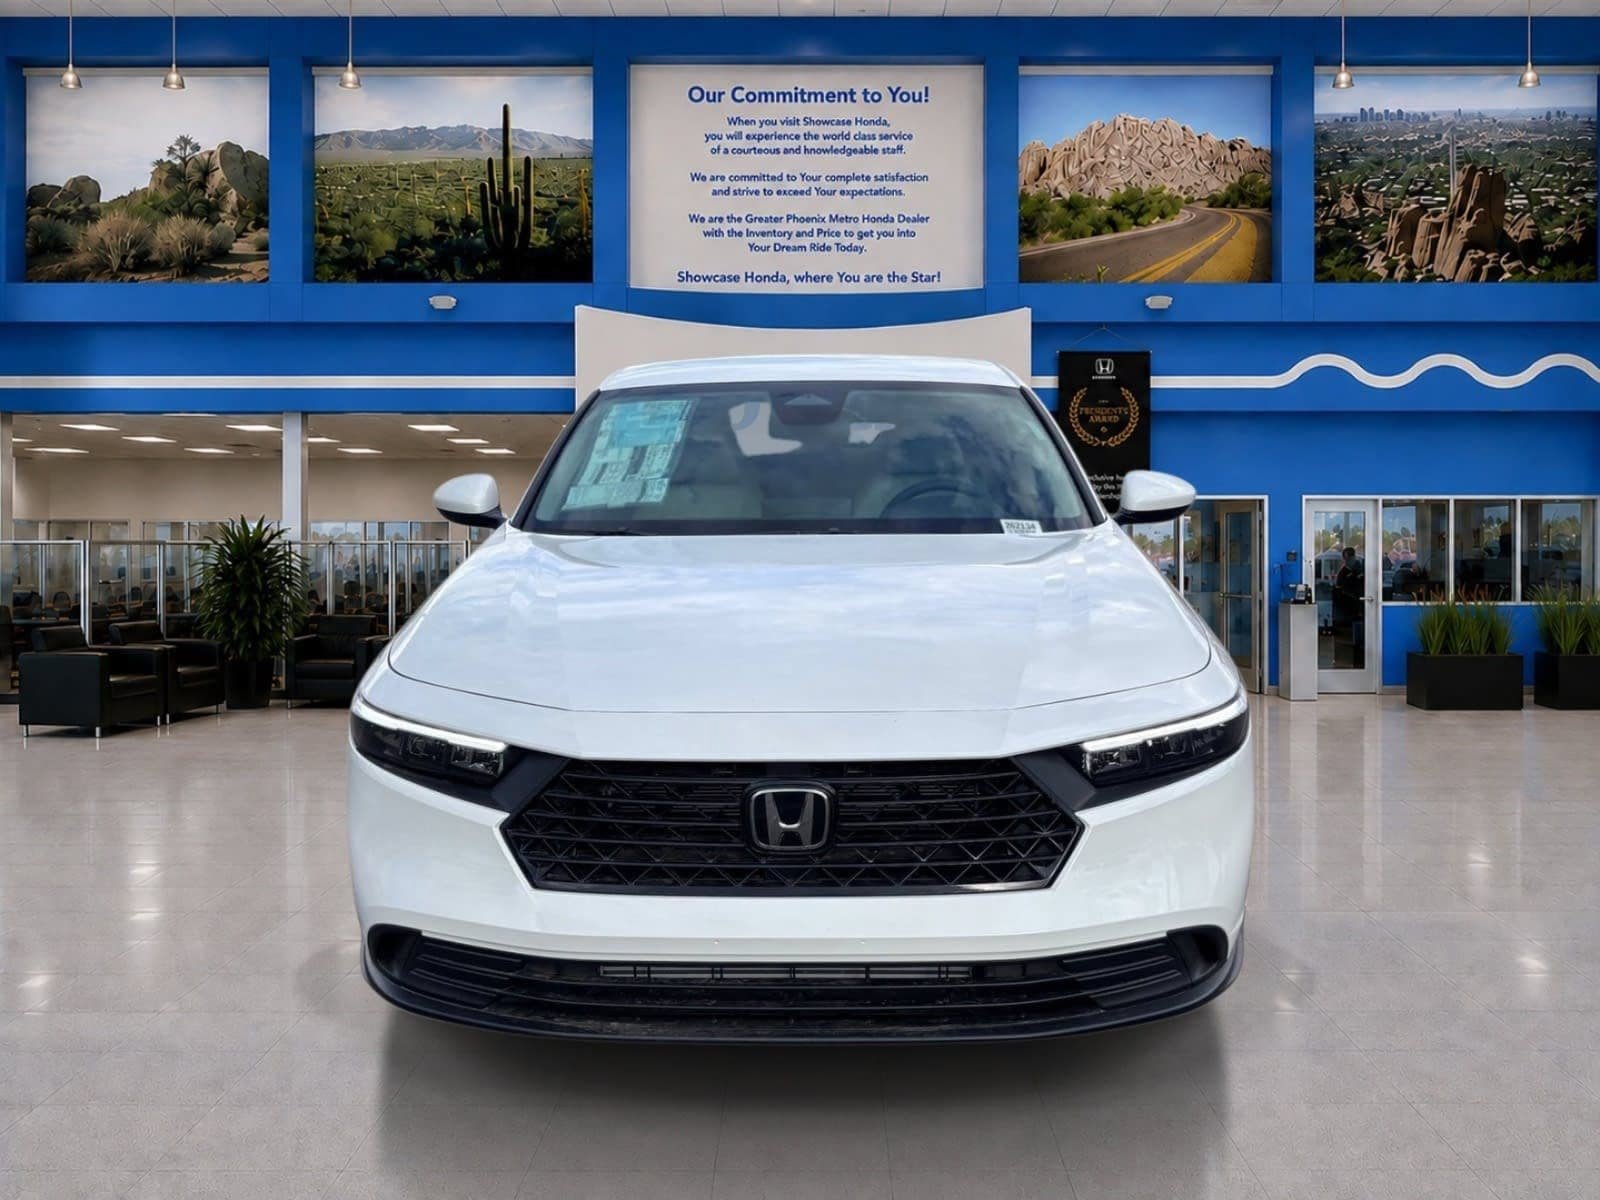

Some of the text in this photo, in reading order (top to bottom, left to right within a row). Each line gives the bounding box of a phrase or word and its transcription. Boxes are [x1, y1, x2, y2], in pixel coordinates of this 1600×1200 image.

[687, 86, 930, 104] Our Commitment to You!
[726, 117, 891, 129] When you visit Showcase Honda,
[704, 131, 914, 144] you will experience the world class service
[710, 145, 721, 155] of
[730, 146, 781, 155] courteous
[782, 145, 802, 155] and
[881, 145, 906, 155] staff.
[689, 173, 708, 183] We
[728, 173, 784, 183] committed
[785, 174, 798, 182] to
[799, 173, 823, 183] Your
[824, 173, 872, 185] complete
[873, 172, 929, 183] satisfaction
[711, 187, 905, 200] and strive to exceed Your expectations.
[688, 214, 931, 224] We are the Greater Phoenix Metro Honda Dealer
[702, 228, 917, 241] with the Inventory and Price to get you into
[747, 243, 867, 255] Your Dream Ride Today.
[677, 271, 941, 285] Showcase Honda, where You are the Star!
